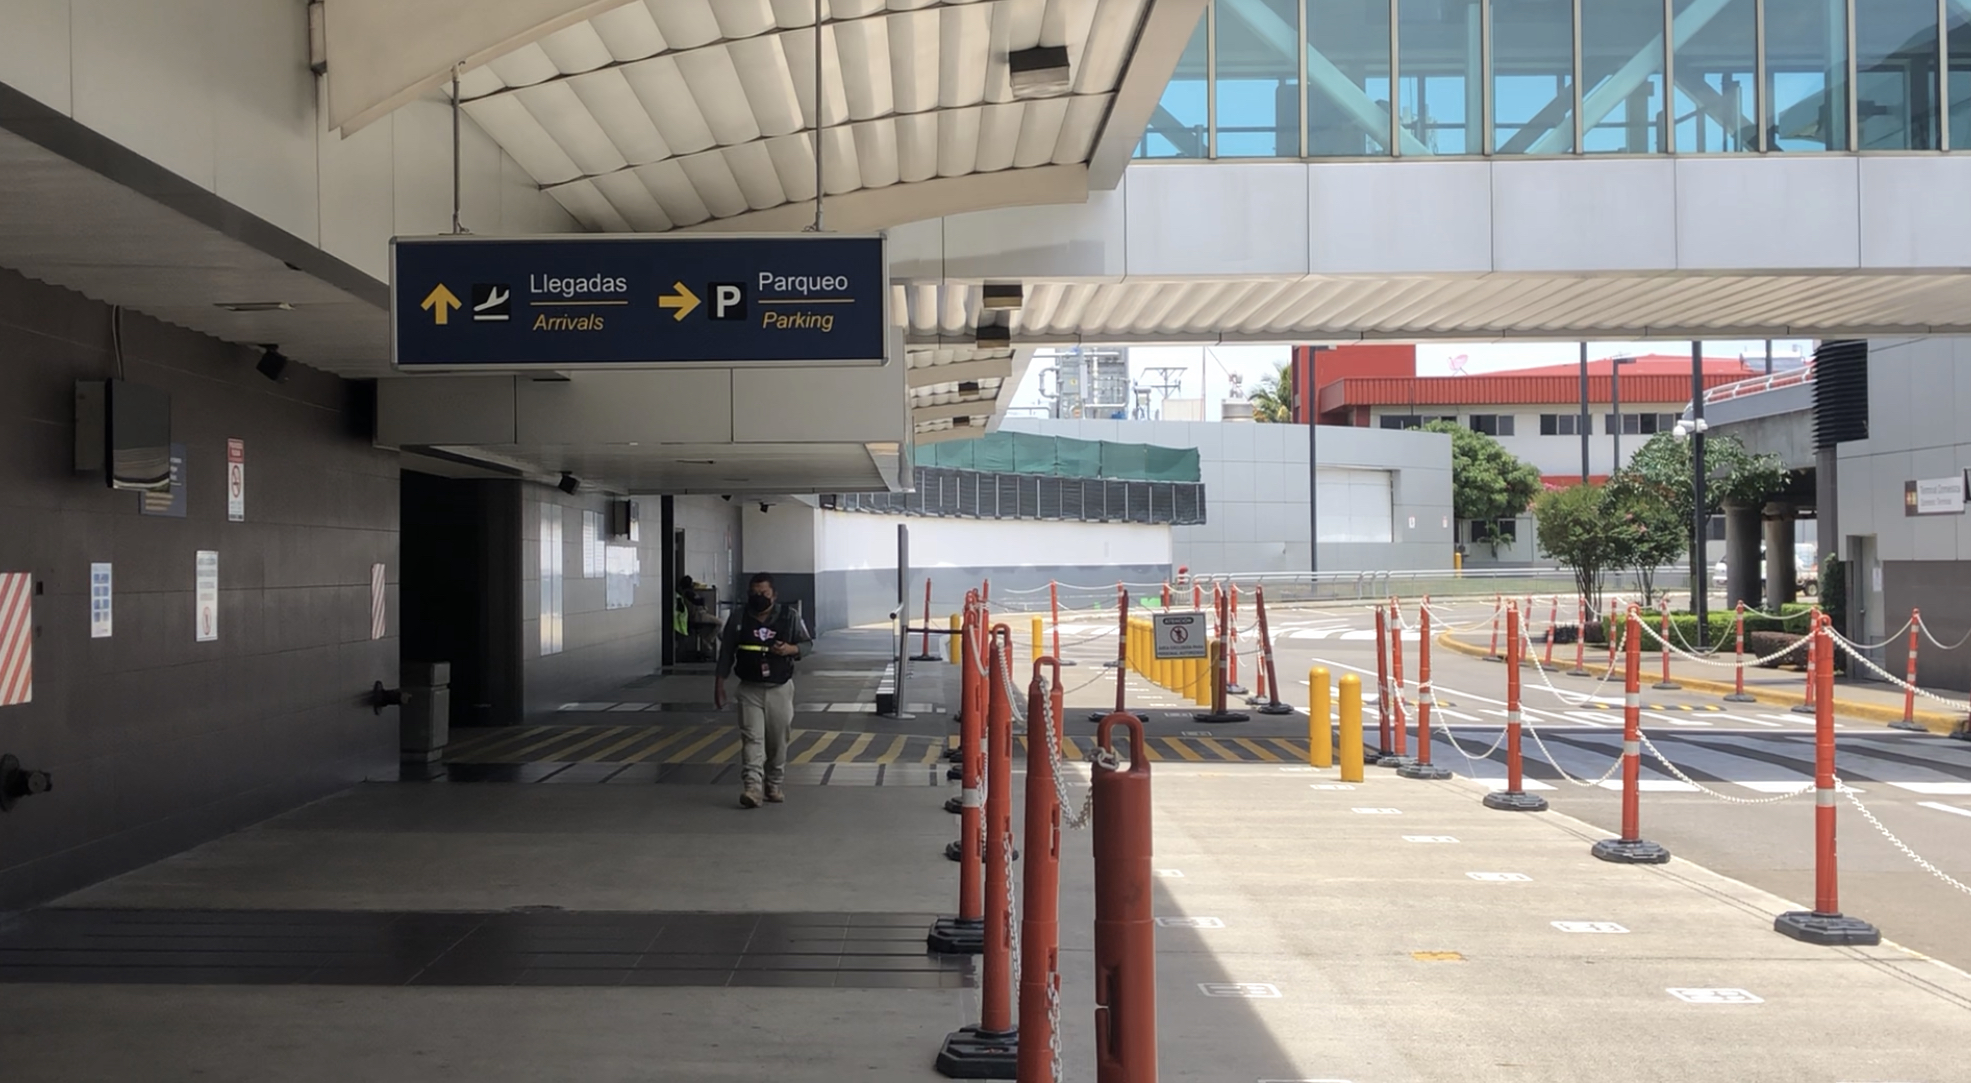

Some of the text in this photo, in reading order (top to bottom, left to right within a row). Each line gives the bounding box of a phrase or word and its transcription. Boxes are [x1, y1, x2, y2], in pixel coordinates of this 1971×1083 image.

[530, 273, 627, 298] Llegadas
[759, 272, 848, 296] Parqueo
[717, 285, 741, 317] P
[533, 313, 604, 331] Arrivals
[763, 312, 834, 332] Parking
